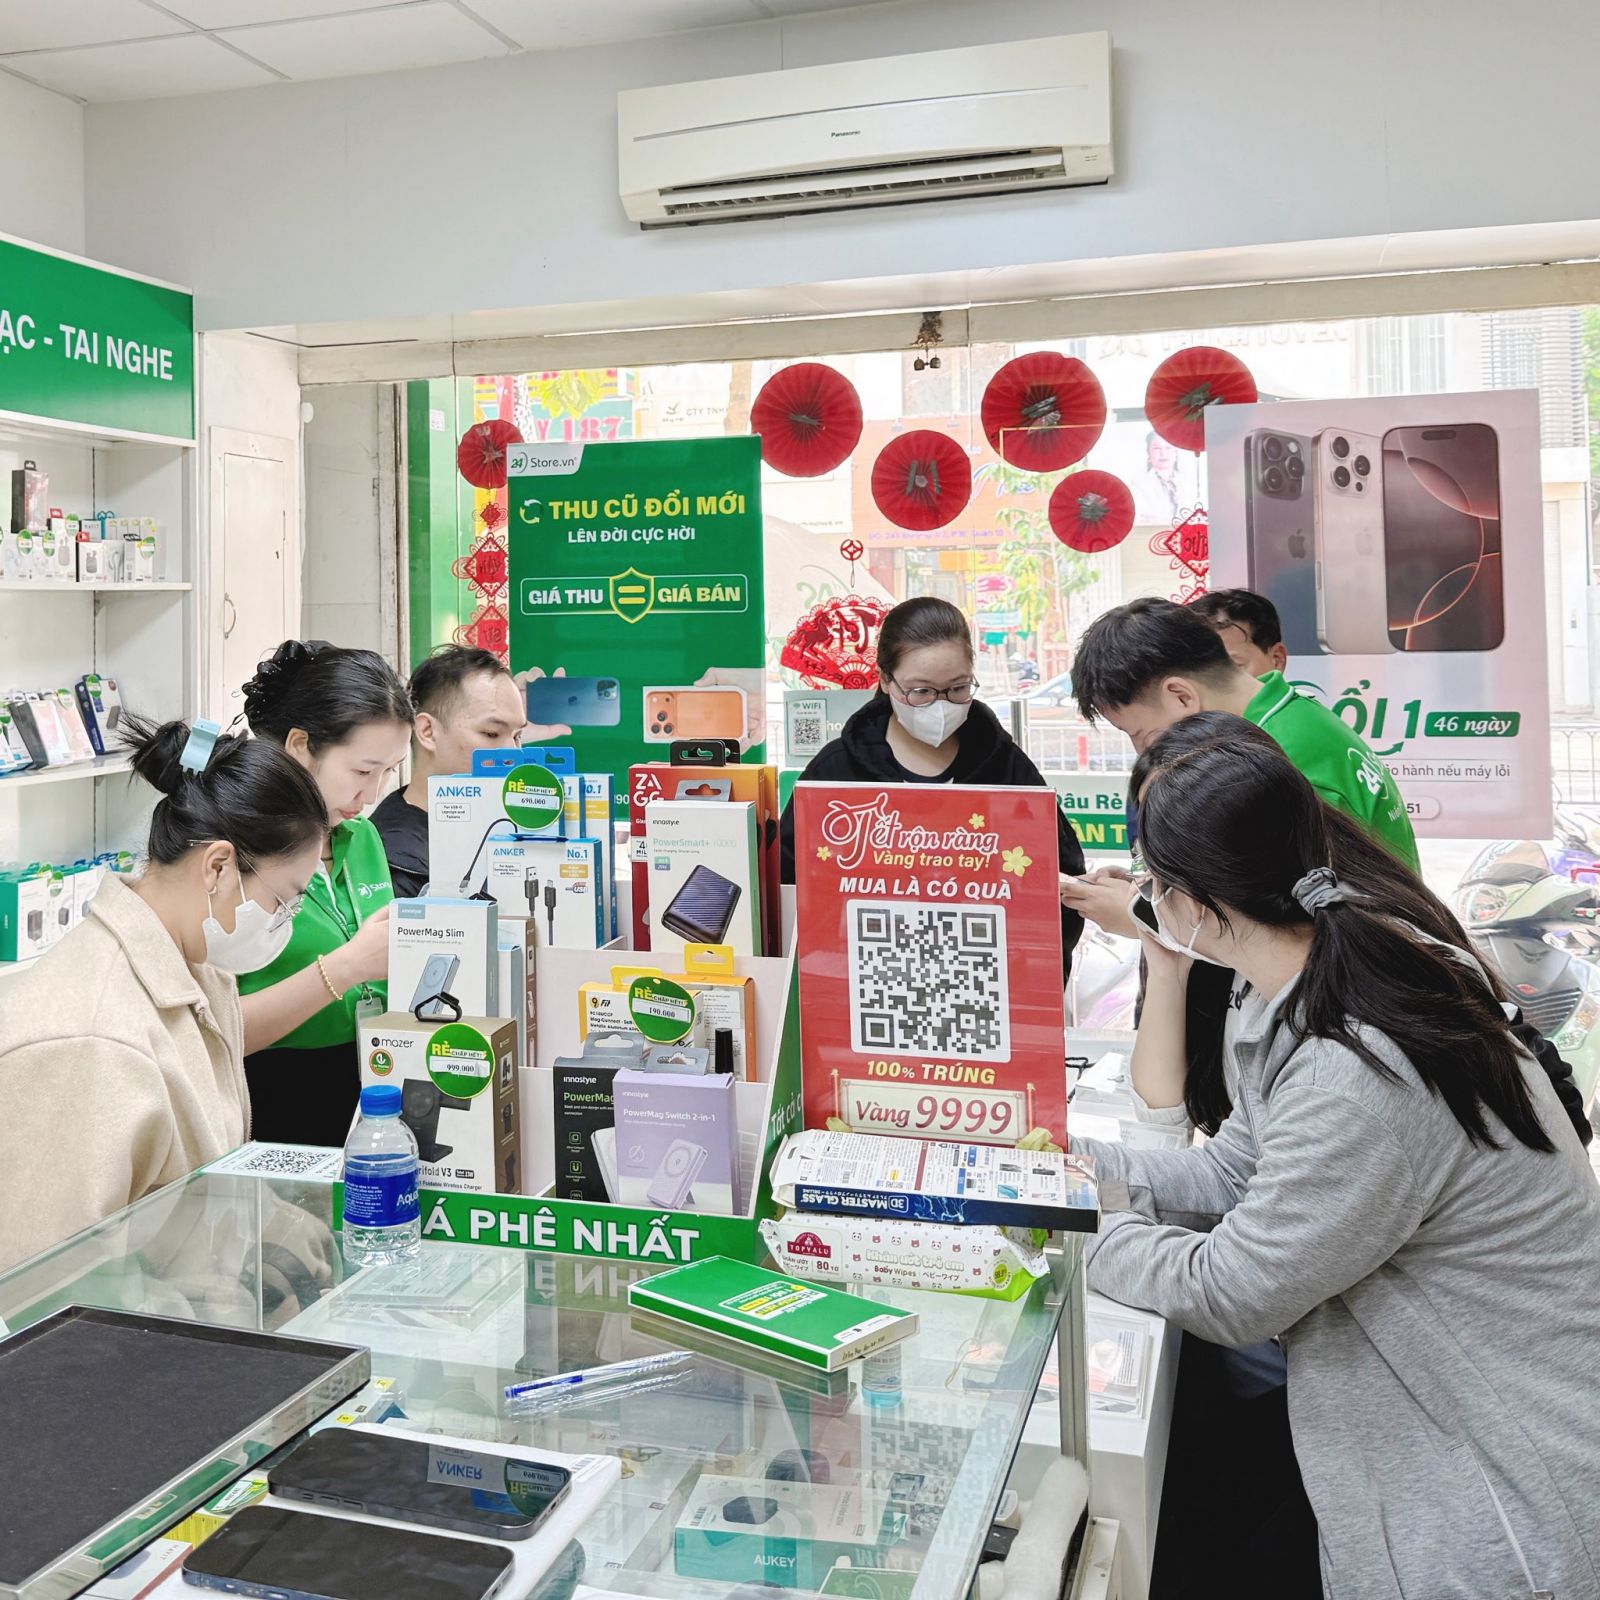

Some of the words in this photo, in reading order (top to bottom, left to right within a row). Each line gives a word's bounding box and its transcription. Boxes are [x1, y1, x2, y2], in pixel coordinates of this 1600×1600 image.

[831, 130, 861, 138] Panasonic
[59, 323, 99, 364] TAI
[106, 335, 173, 381] NGHE
[549, 500, 597, 520] THU
[604, 494, 638, 519] CŨ
[645, 489, 689, 518] ĐỔI
[696, 490, 746, 515] MỚI
[567, 528, 597, 543] LÊN
[600, 526, 627, 542] ĐỜI
[631, 528, 664, 544] CỰC
[667, 525, 696, 541] HỜI
[528, 586, 561, 604] GIÁ
[564, 589, 603, 604] THU
[657, 584, 690, 603] GIÁ
[693, 583, 741, 603] BÁN
[1403, 700, 1422, 739] 1
[1433, 716, 1459, 732] 46
[1464, 716, 1512, 735] ngày
[1402, 763, 1434, 777] hành
[1437, 762, 1461, 777] nếu
[1465, 763, 1492, 779] máy
[1495, 763, 1510, 777] lỗi
[436, 786, 482, 797] ANKER
[508, 779, 525, 793] RẺ
[1096, 793, 1123, 809] Rẻ
[900, 826, 941, 854] rộn
[942, 827, 998, 854] ràng
[493, 848, 525, 856] ANKER
[567, 849, 588, 858] No.1
[873, 850, 915, 869] Vàng
[919, 852, 954, 867] trao
[958, 855, 990, 871] tay!
[839, 877, 887, 895] MUA
[893, 876, 920, 896] LÀ
[927, 876, 958, 897] CÓ
[964, 879, 1012, 900] QUÀ
[397, 927, 444, 938] PowerMag
[445, 928, 465, 937] Slim
[634, 986, 652, 1000] RẺ
[432, 1041, 451, 1056] RẺ
[447, 1064, 474, 1073] 999.000
[866, 1060, 915, 1078] 100%
[921, 1061, 996, 1085] TRÚNG
[563, 1076, 597, 1084] innostyle
[623, 1109, 664, 1121] PowerMag
[665, 1110, 691, 1120] Switch
[692, 1113, 716, 1121] 2-in-1
[855, 1100, 911, 1128] Vàng
[916, 1095, 1013, 1135] 9999
[441, 1168, 452, 1177] V3
[464, 1183, 482, 1191] Charger
[802, 1193, 840, 1205] GLASS
[841, 1197, 888, 1209] MASTER
[890, 1198, 905, 1209] 3D
[470, 1207, 558, 1248] PHÊ
[573, 1214, 701, 1261] NHẤT
[790, 1245, 829, 1255] TOPVALU
[816, 1260, 829, 1270] 80
[874, 1265, 893, 1275] Baby
[894, 1267, 917, 1277] Wipes
[944, 1261, 965, 1272] em
[753, 1555, 795, 1568] AUKEY
